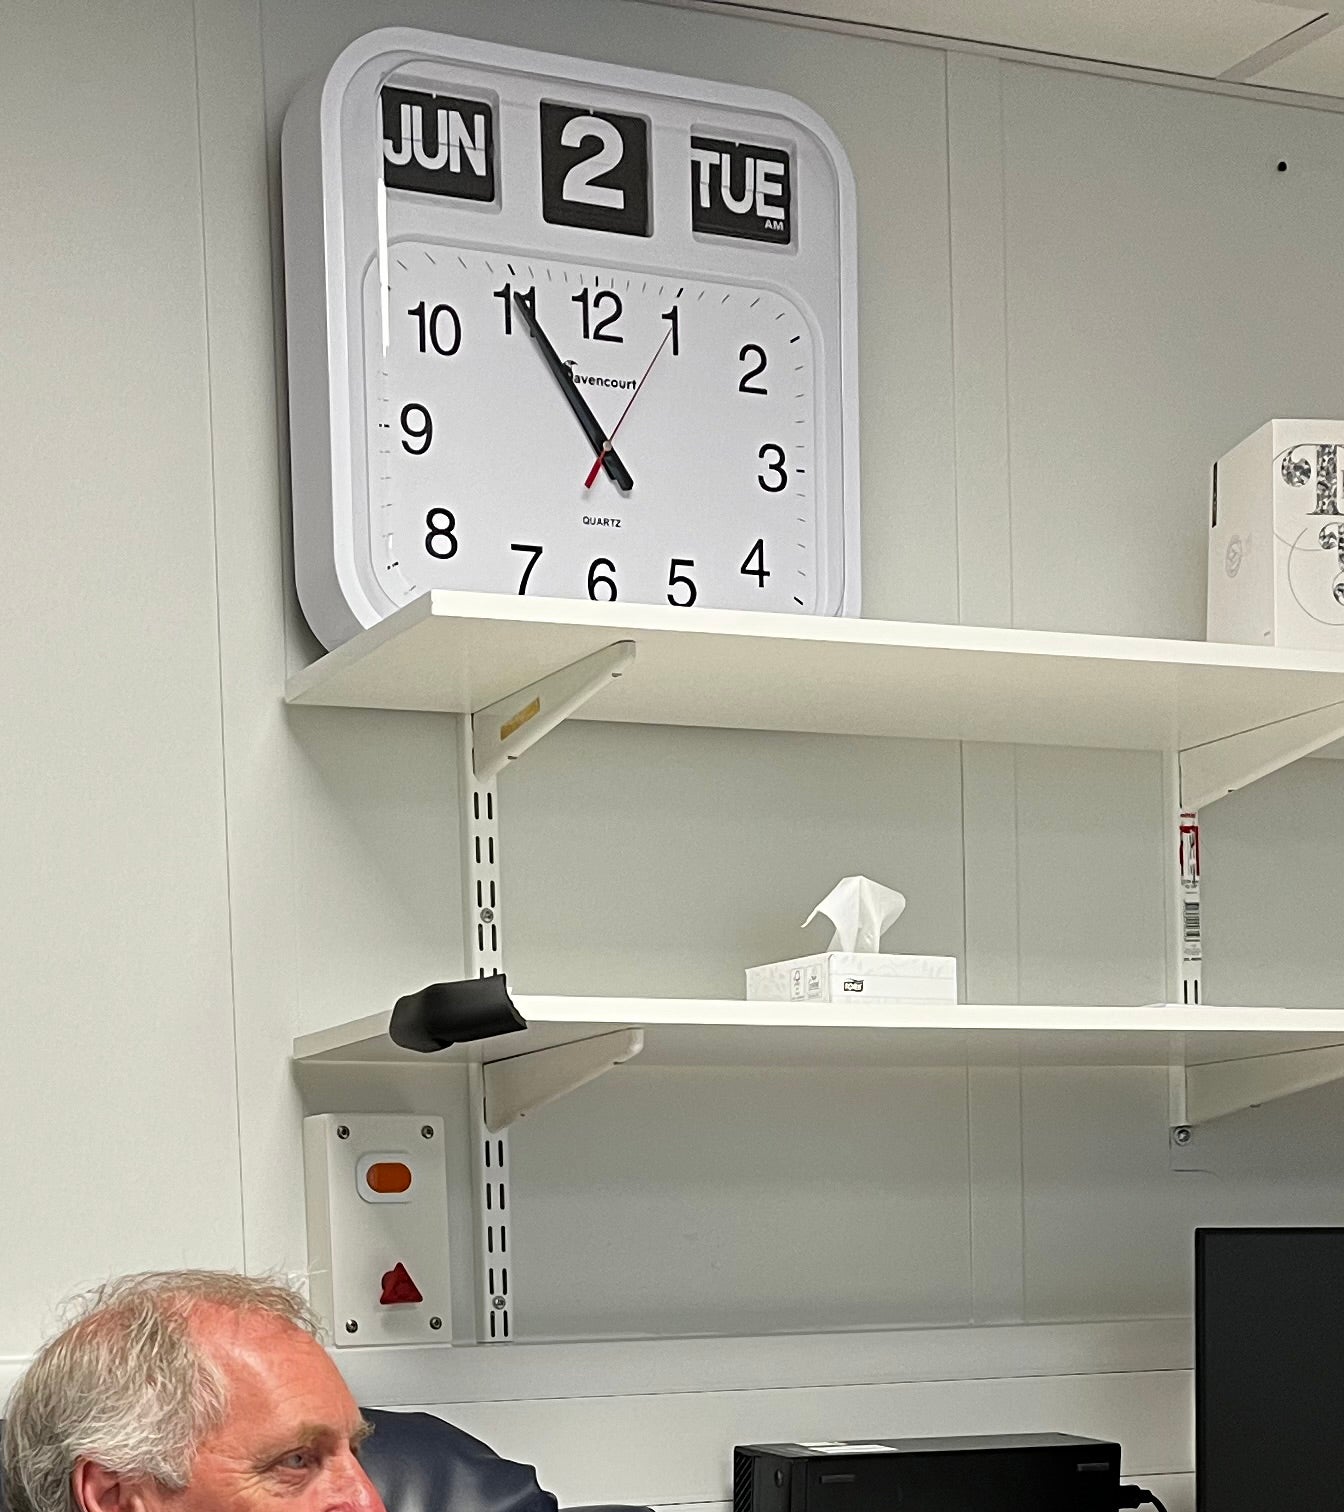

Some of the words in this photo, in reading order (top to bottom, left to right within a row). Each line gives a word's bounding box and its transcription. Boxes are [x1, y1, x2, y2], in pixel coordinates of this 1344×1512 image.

[383, 104, 487, 176] JUN
[560, 115, 625, 210] 2
[691, 148, 785, 219] TUE
[764, 219, 785, 231] AM
[407, 300, 462, 356] 10
[571, 287, 624, 344] 12
[661, 305, 681, 356] 1
[569, 372, 637, 390] avencourt
[737, 343, 769, 395] 2
[399, 402, 434, 455] 9
[757, 443, 788, 493] 3
[425, 507, 458, 560] 8
[582, 515, 622, 528] QUARTZ
[511, 543, 544, 596] 7
[587, 557, 618, 602] 6
[667, 558, 698, 607] 5
[740, 538, 771, 588] 4
